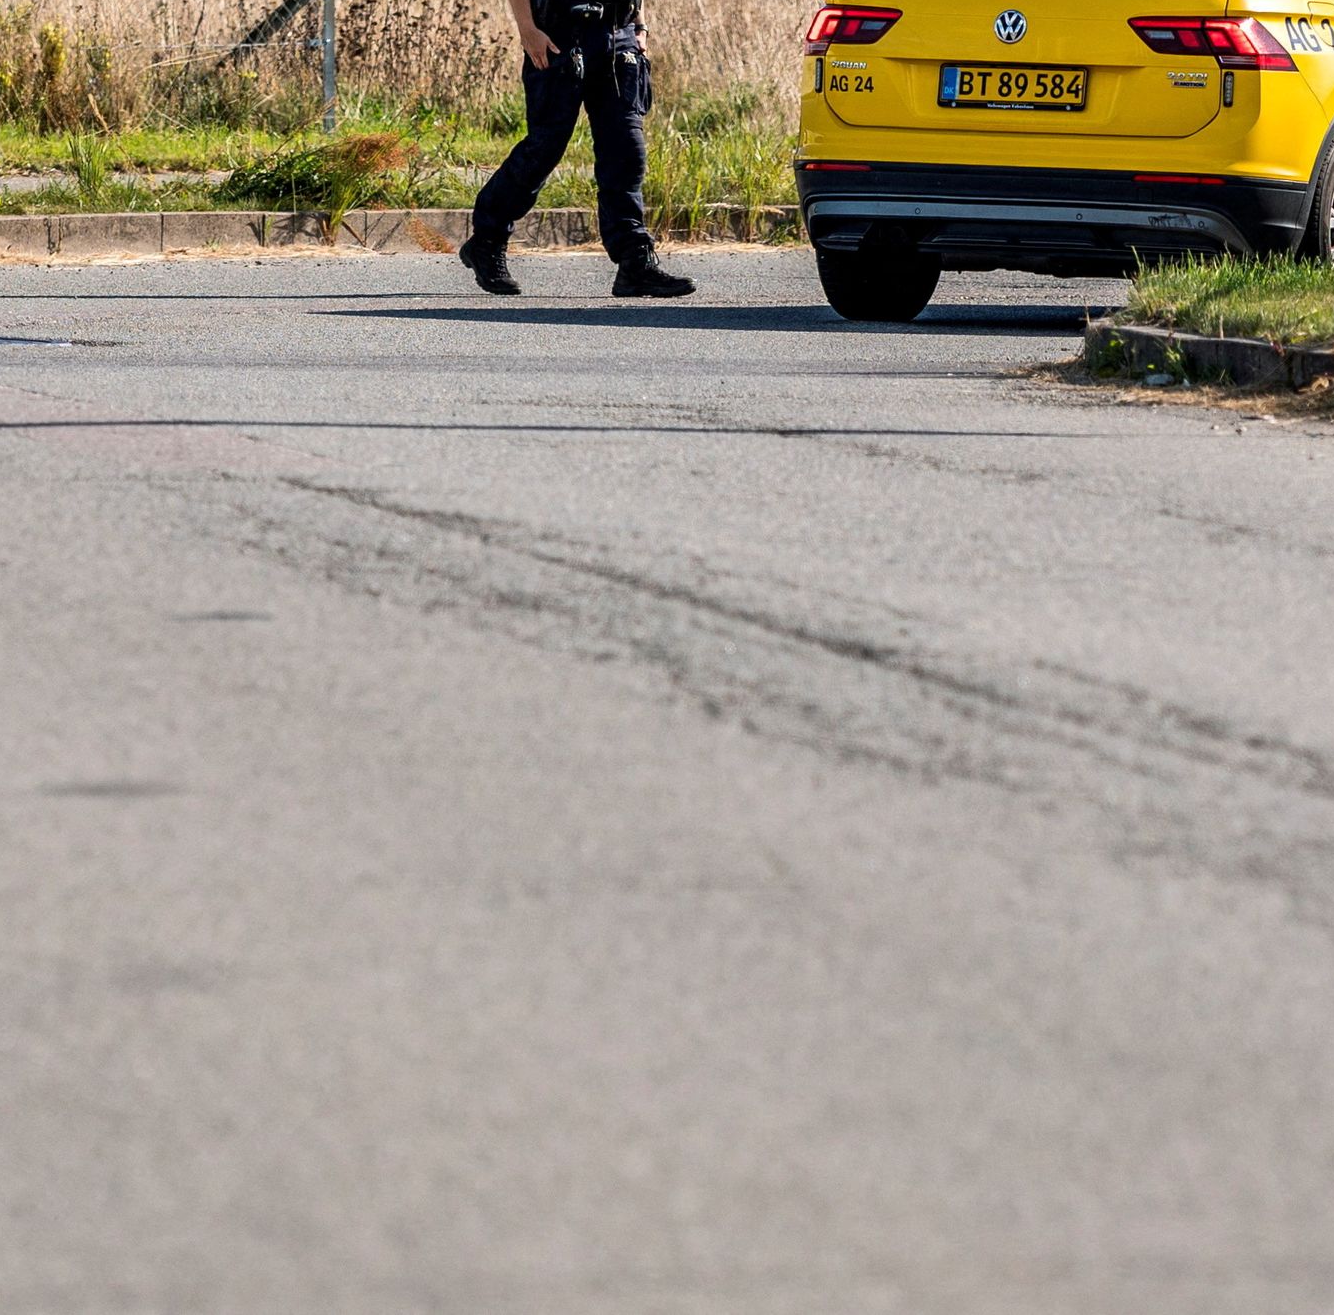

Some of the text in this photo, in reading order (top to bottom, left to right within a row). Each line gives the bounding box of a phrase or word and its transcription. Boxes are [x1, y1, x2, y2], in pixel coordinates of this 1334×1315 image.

[995, 10, 1027, 44] VW
[1285, 16, 1323, 52] AG
[829, 75, 875, 93] AG 24
[944, 86, 955, 94] DK
[959, 71, 1082, 99] BT 89 584
